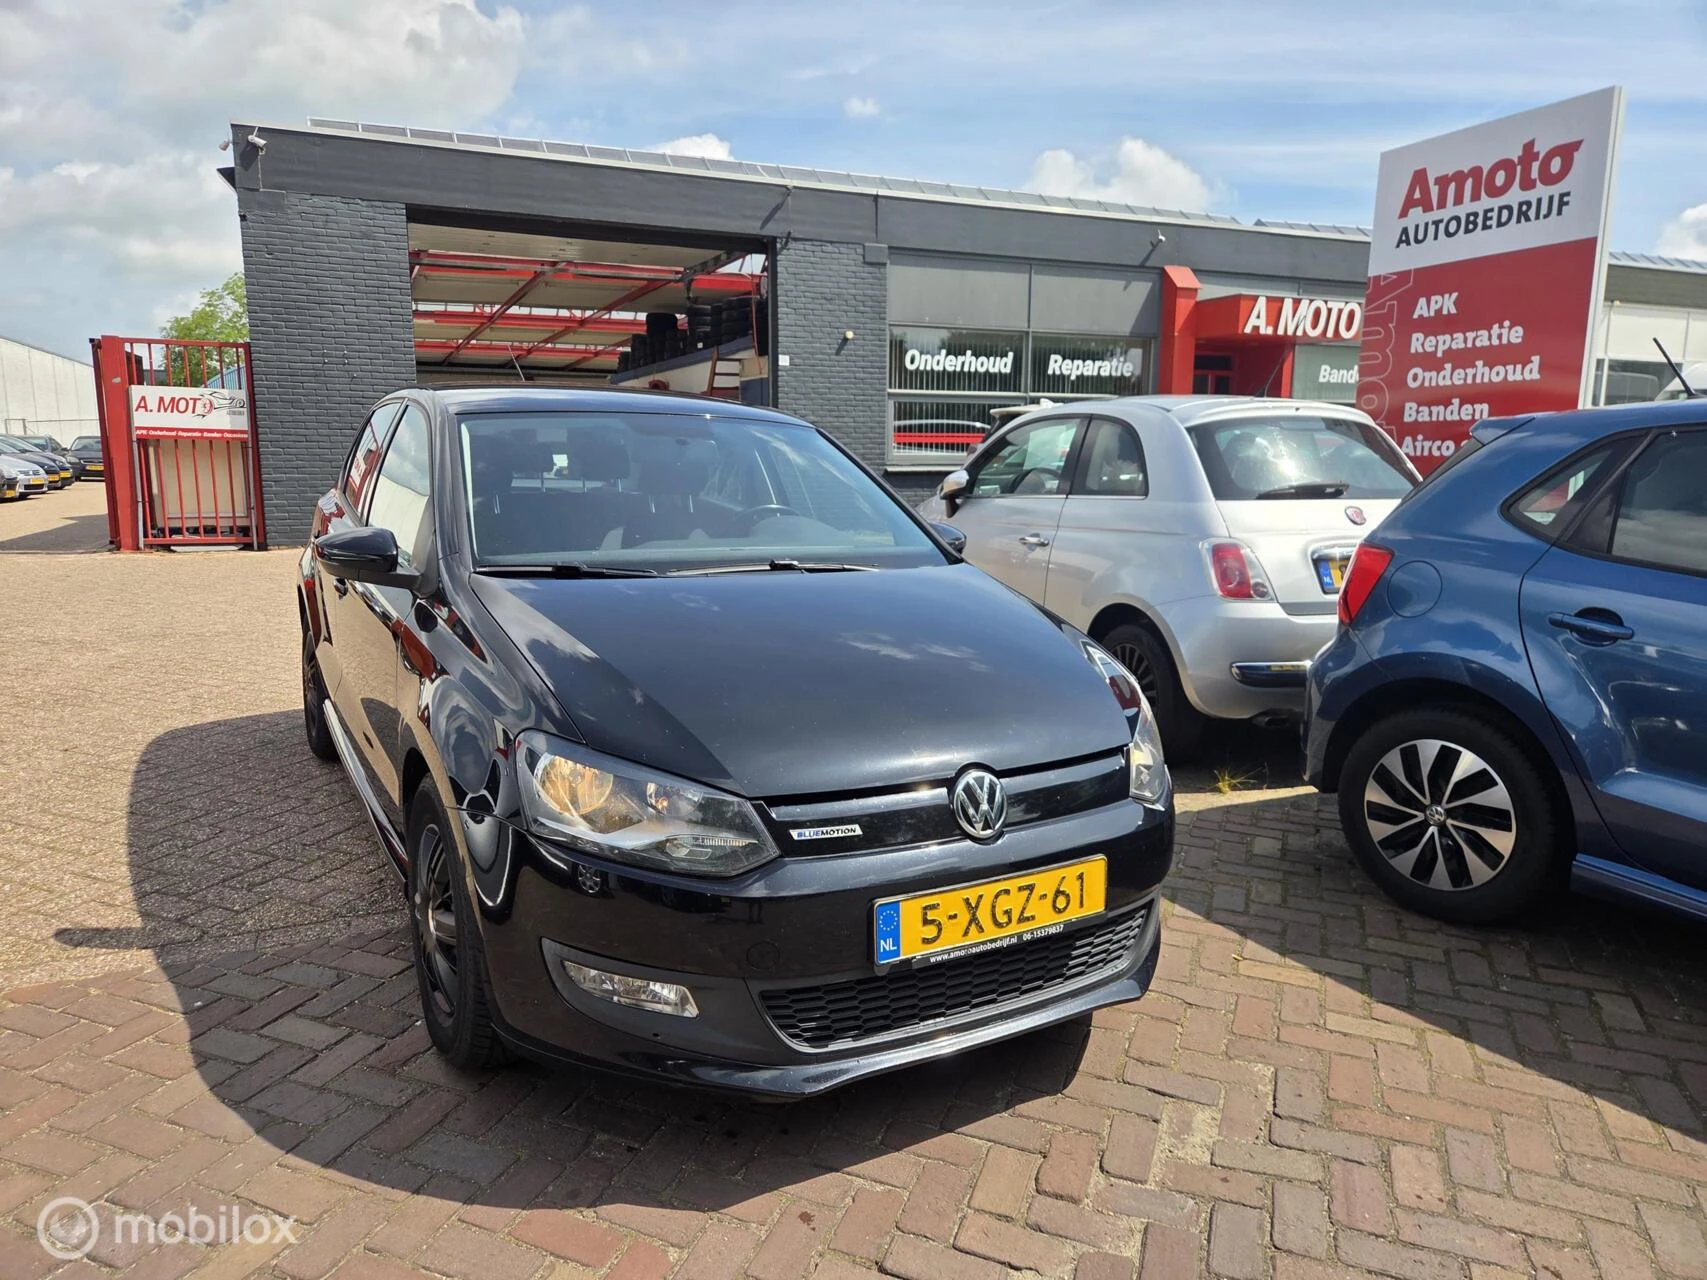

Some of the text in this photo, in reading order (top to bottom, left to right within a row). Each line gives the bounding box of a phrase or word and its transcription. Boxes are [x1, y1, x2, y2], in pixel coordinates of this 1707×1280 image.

[1398, 137, 1584, 219] Amoto
[1395, 191, 1572, 249] AUTOBEDRIJF
[1243, 296, 1362, 339] A. MOTO
[1413, 292, 1459, 319] APK
[1410, 320, 1524, 358] Reparatie
[904, 349, 1014, 374] Onderhoud
[1048, 353, 1135, 381] Reparatie
[1318, 364, 1360, 384] Band
[1406, 355, 1541, 389] Onderhoud
[1403, 398, 1489, 423] Banden
[1401, 434, 1456, 457] Airco
[797, 827, 857, 839] BLUEMOTION
[880, 871, 1086, 952] NL 5-XGZ-61
